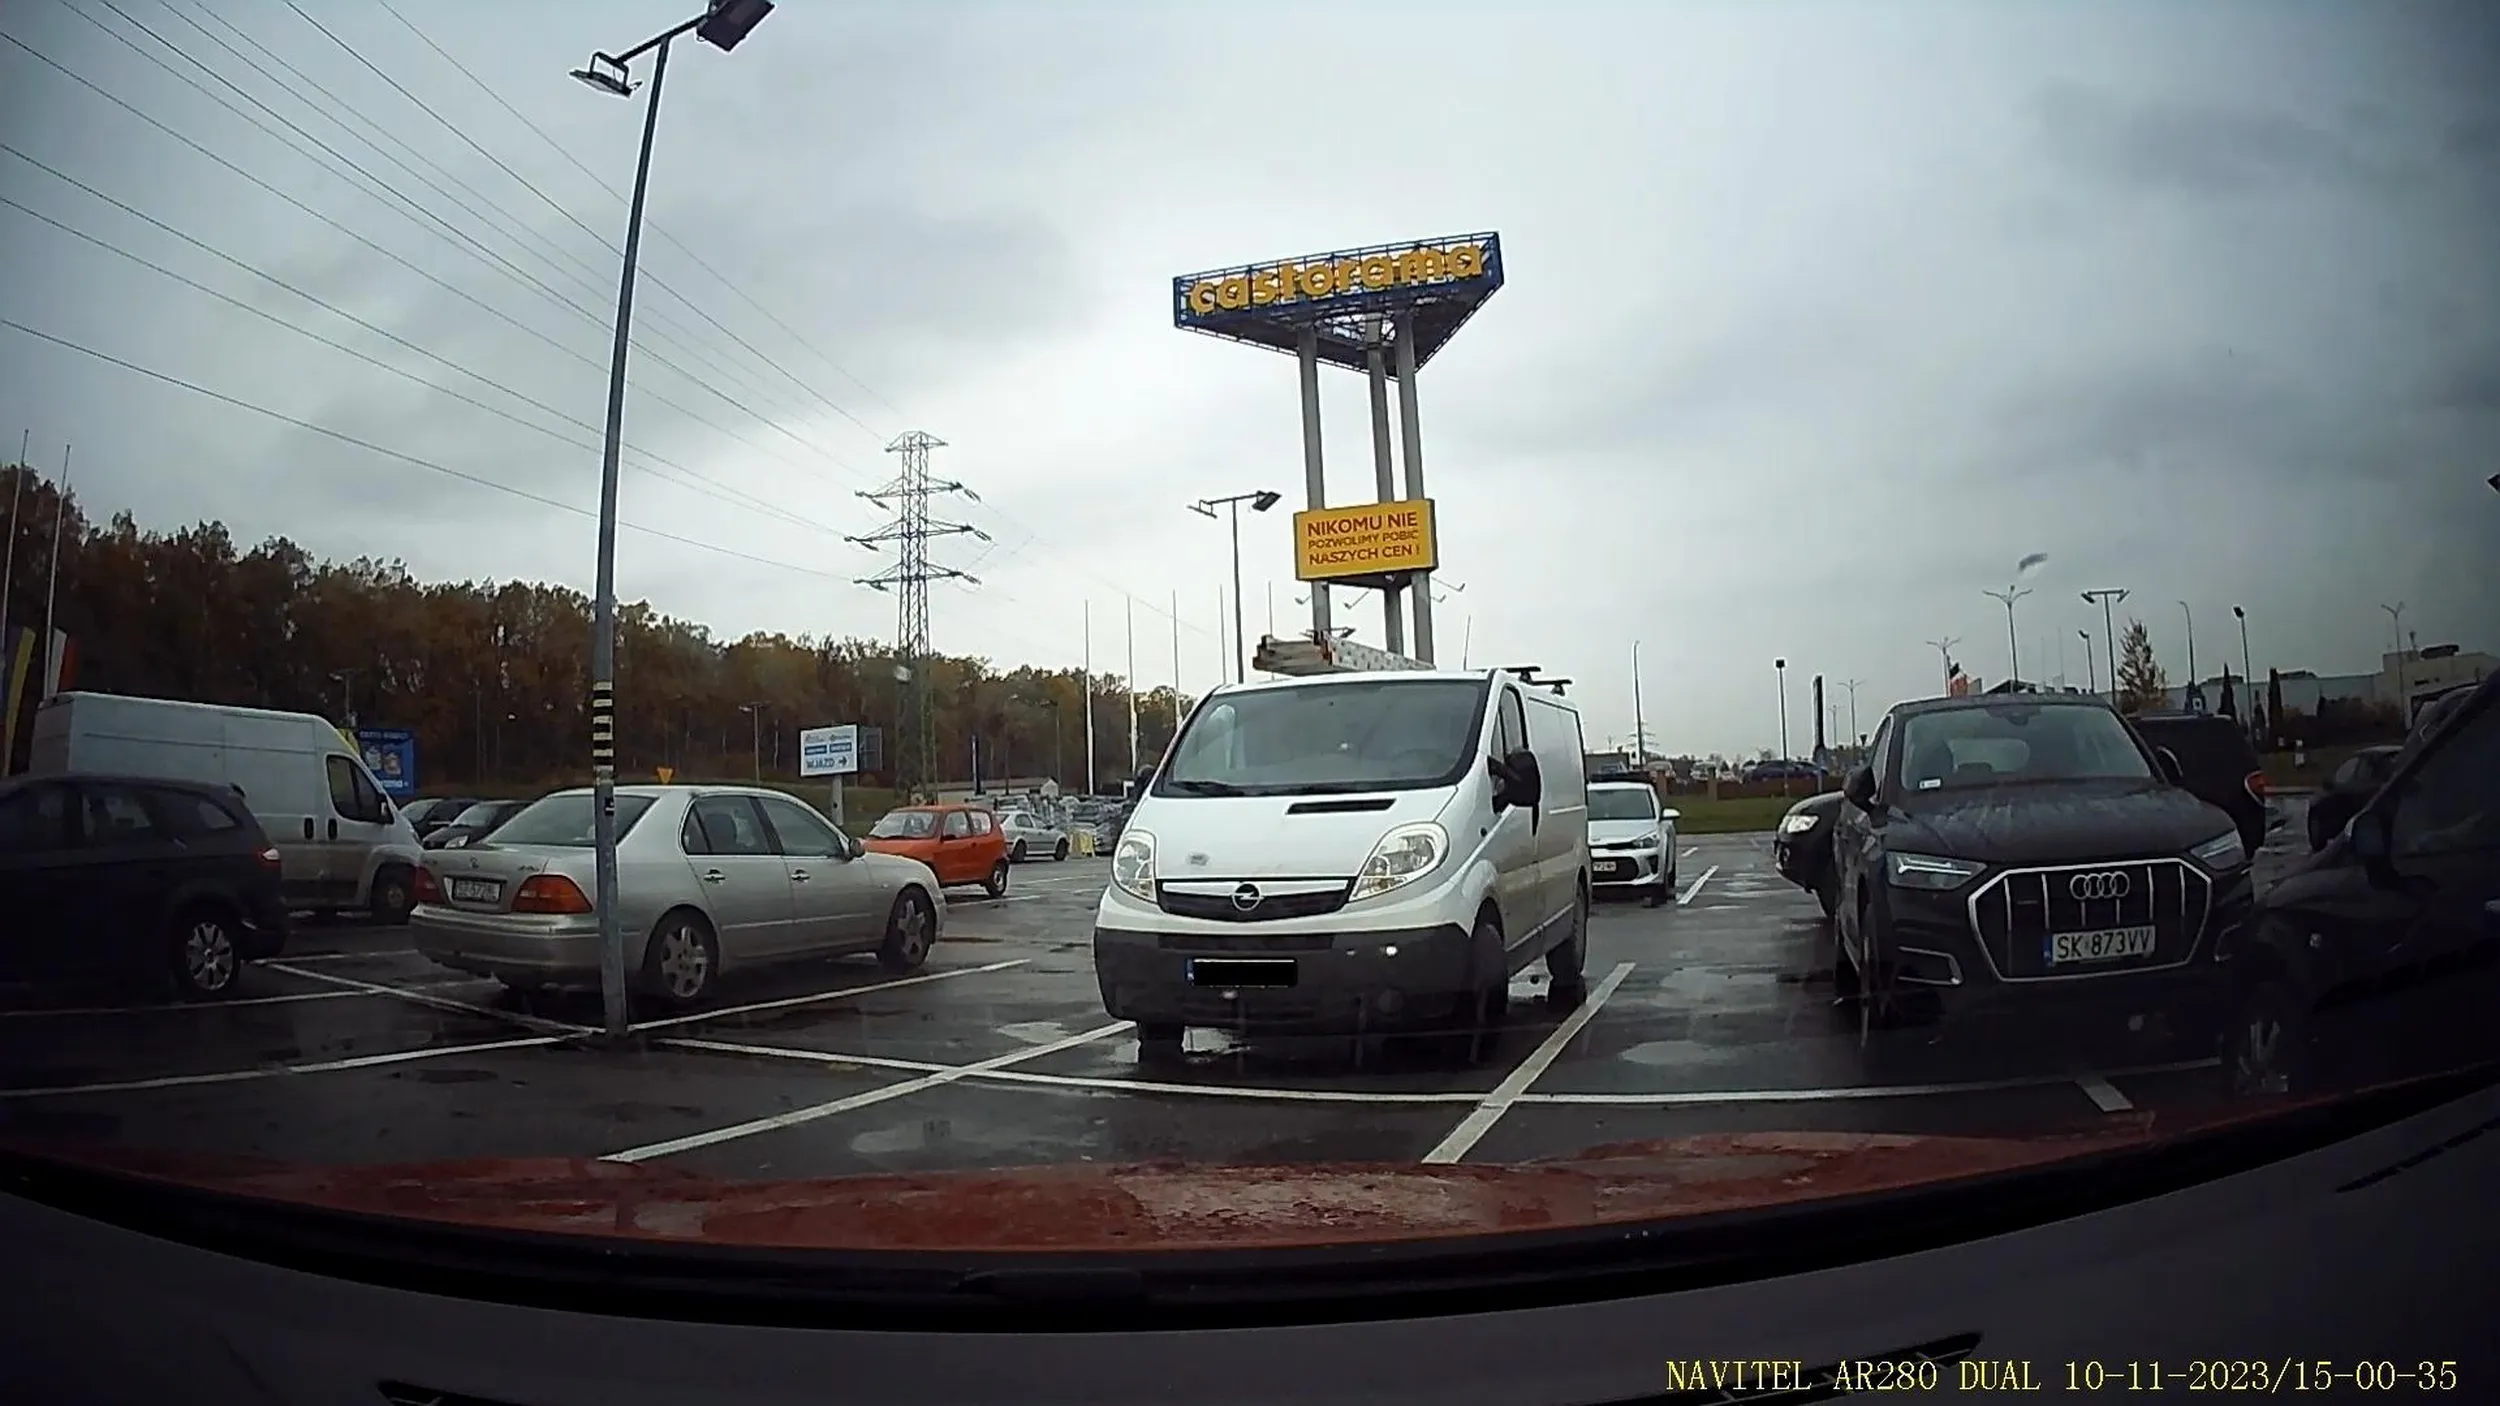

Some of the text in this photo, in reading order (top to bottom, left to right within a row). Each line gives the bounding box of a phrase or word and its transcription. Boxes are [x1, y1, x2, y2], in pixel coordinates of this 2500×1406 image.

[1190, 244, 1482, 315] castorama
[1307, 511, 1418, 536] NIKOMU NIE
[1308, 533, 1379, 549] POZWOLIMY
[1309, 550, 1378, 565] NASZYCH
[1382, 546, 1412, 557] CEN
[2057, 931, 2150, 959] SK 873VV
